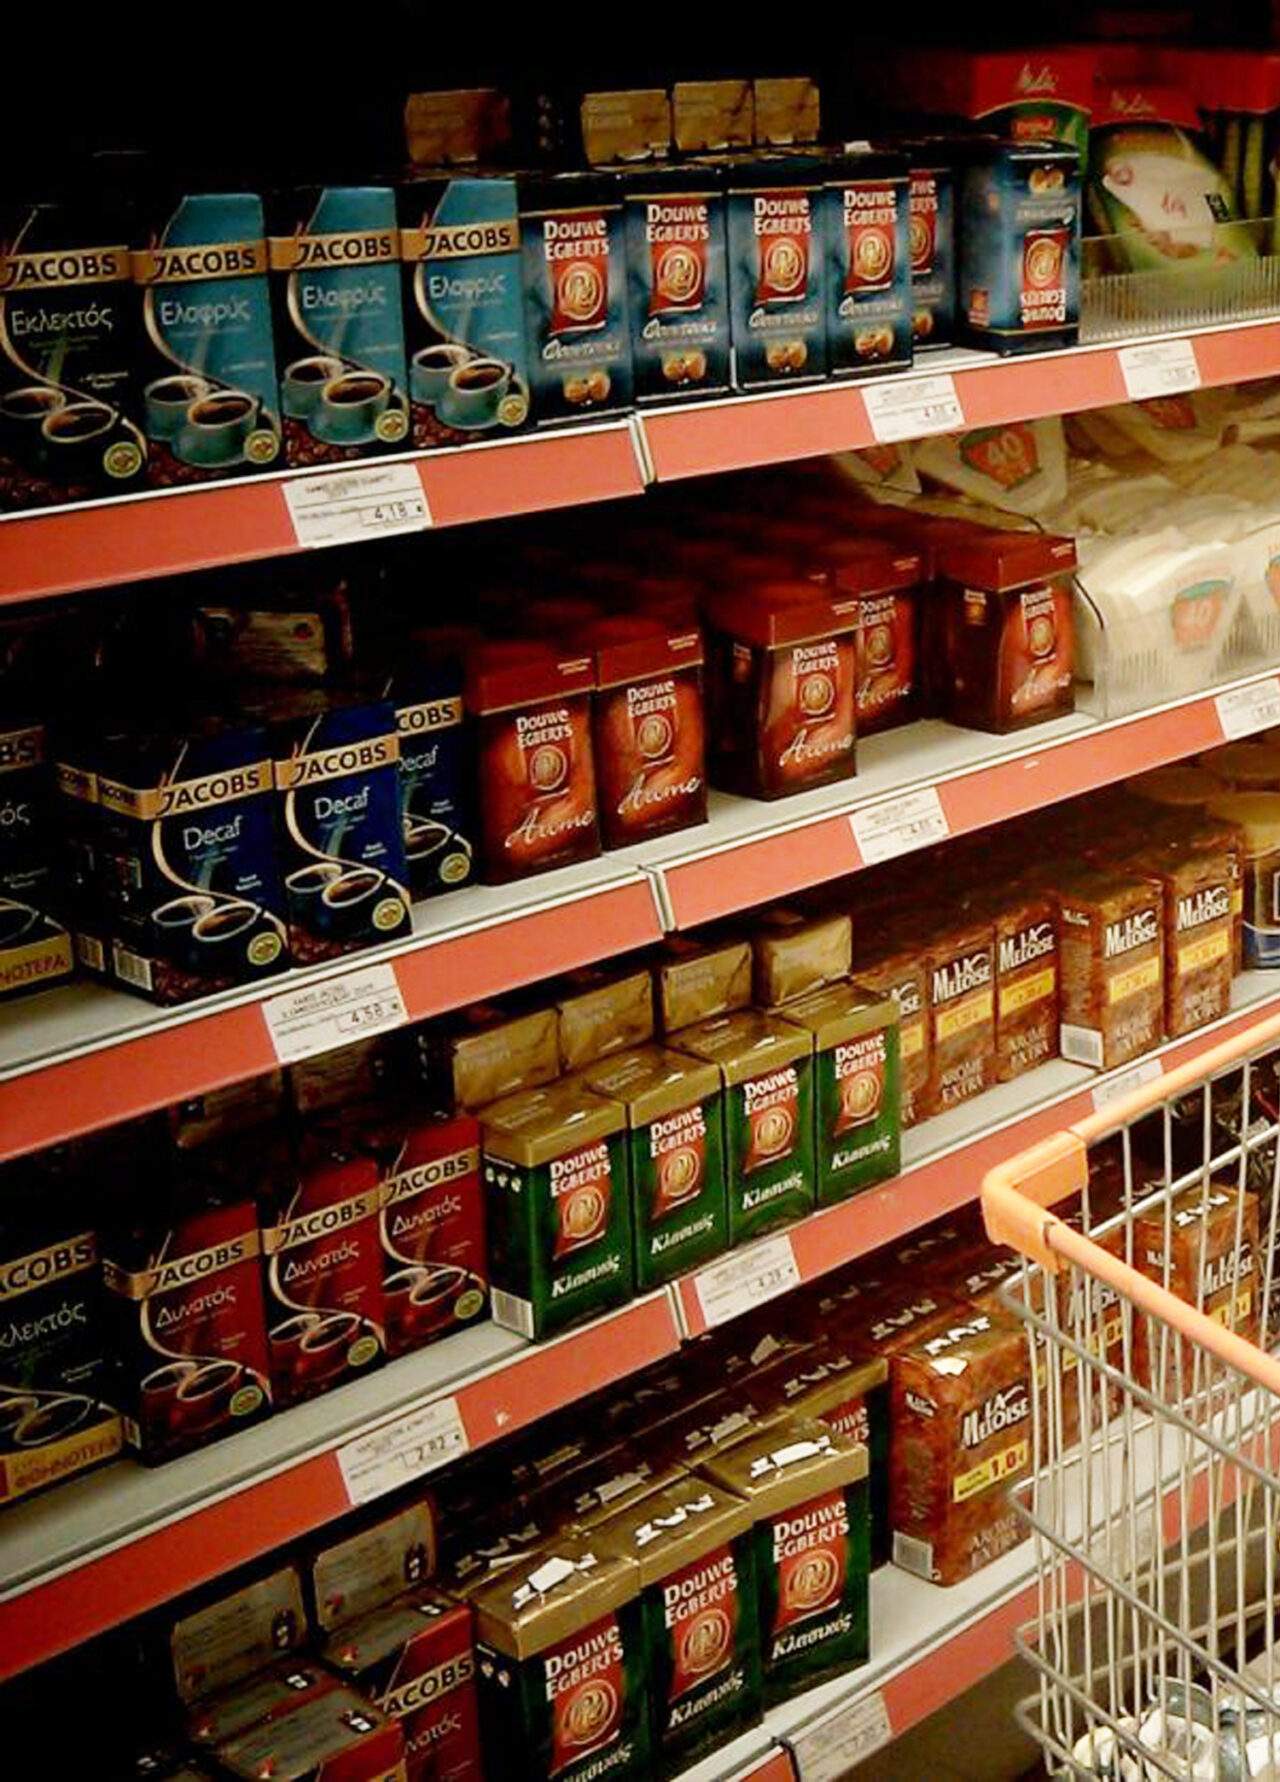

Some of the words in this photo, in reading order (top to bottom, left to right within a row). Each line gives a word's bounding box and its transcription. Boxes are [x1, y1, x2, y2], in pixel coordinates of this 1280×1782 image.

[645, 224, 710, 242] EGBERTS
[754, 215, 811, 236] EGBERTS
[844, 208, 898, 226] EGBERTS
[296, 236, 393, 266] JACOBS
[422, 227, 512, 257] JACOBS
[545, 238, 610, 261] EGBERTS
[2, 256, 118, 289] JACOBS
[152, 248, 257, 283] JACOBS
[11, 304, 114, 335] Εκλεκτός
[397, 702, 456, 733] COBS
[289, 742, 388, 784] JACOBS
[158, 770, 261, 817] JACOBS
[314, 786, 371, 820] Decaf
[183, 814, 243, 852] Decaf
[835, 1048, 887, 1080] EGBERTS
[744, 1083, 800, 1116] EGBERTS
[651, 1121, 707, 1158] EGBERTS
[386, 1155, 470, 1202] JACOBS
[550, 1158, 612, 1198] EGBERTS
[280, 1199, 368, 1247] JACOBS
[6, 1244, 94, 1289] COBS
[150, 1241, 245, 1291] JACOBS
[0, 1301, 87, 1348] λεκτός
[773, 1517, 850, 1564] EGBERTS
[665, 1573, 739, 1630] EGBERTS
[381, 1655, 476, 1713] ACOBS
[545, 1642, 625, 1703] EGBERTS
[404, 1709, 463, 1754] νατός
